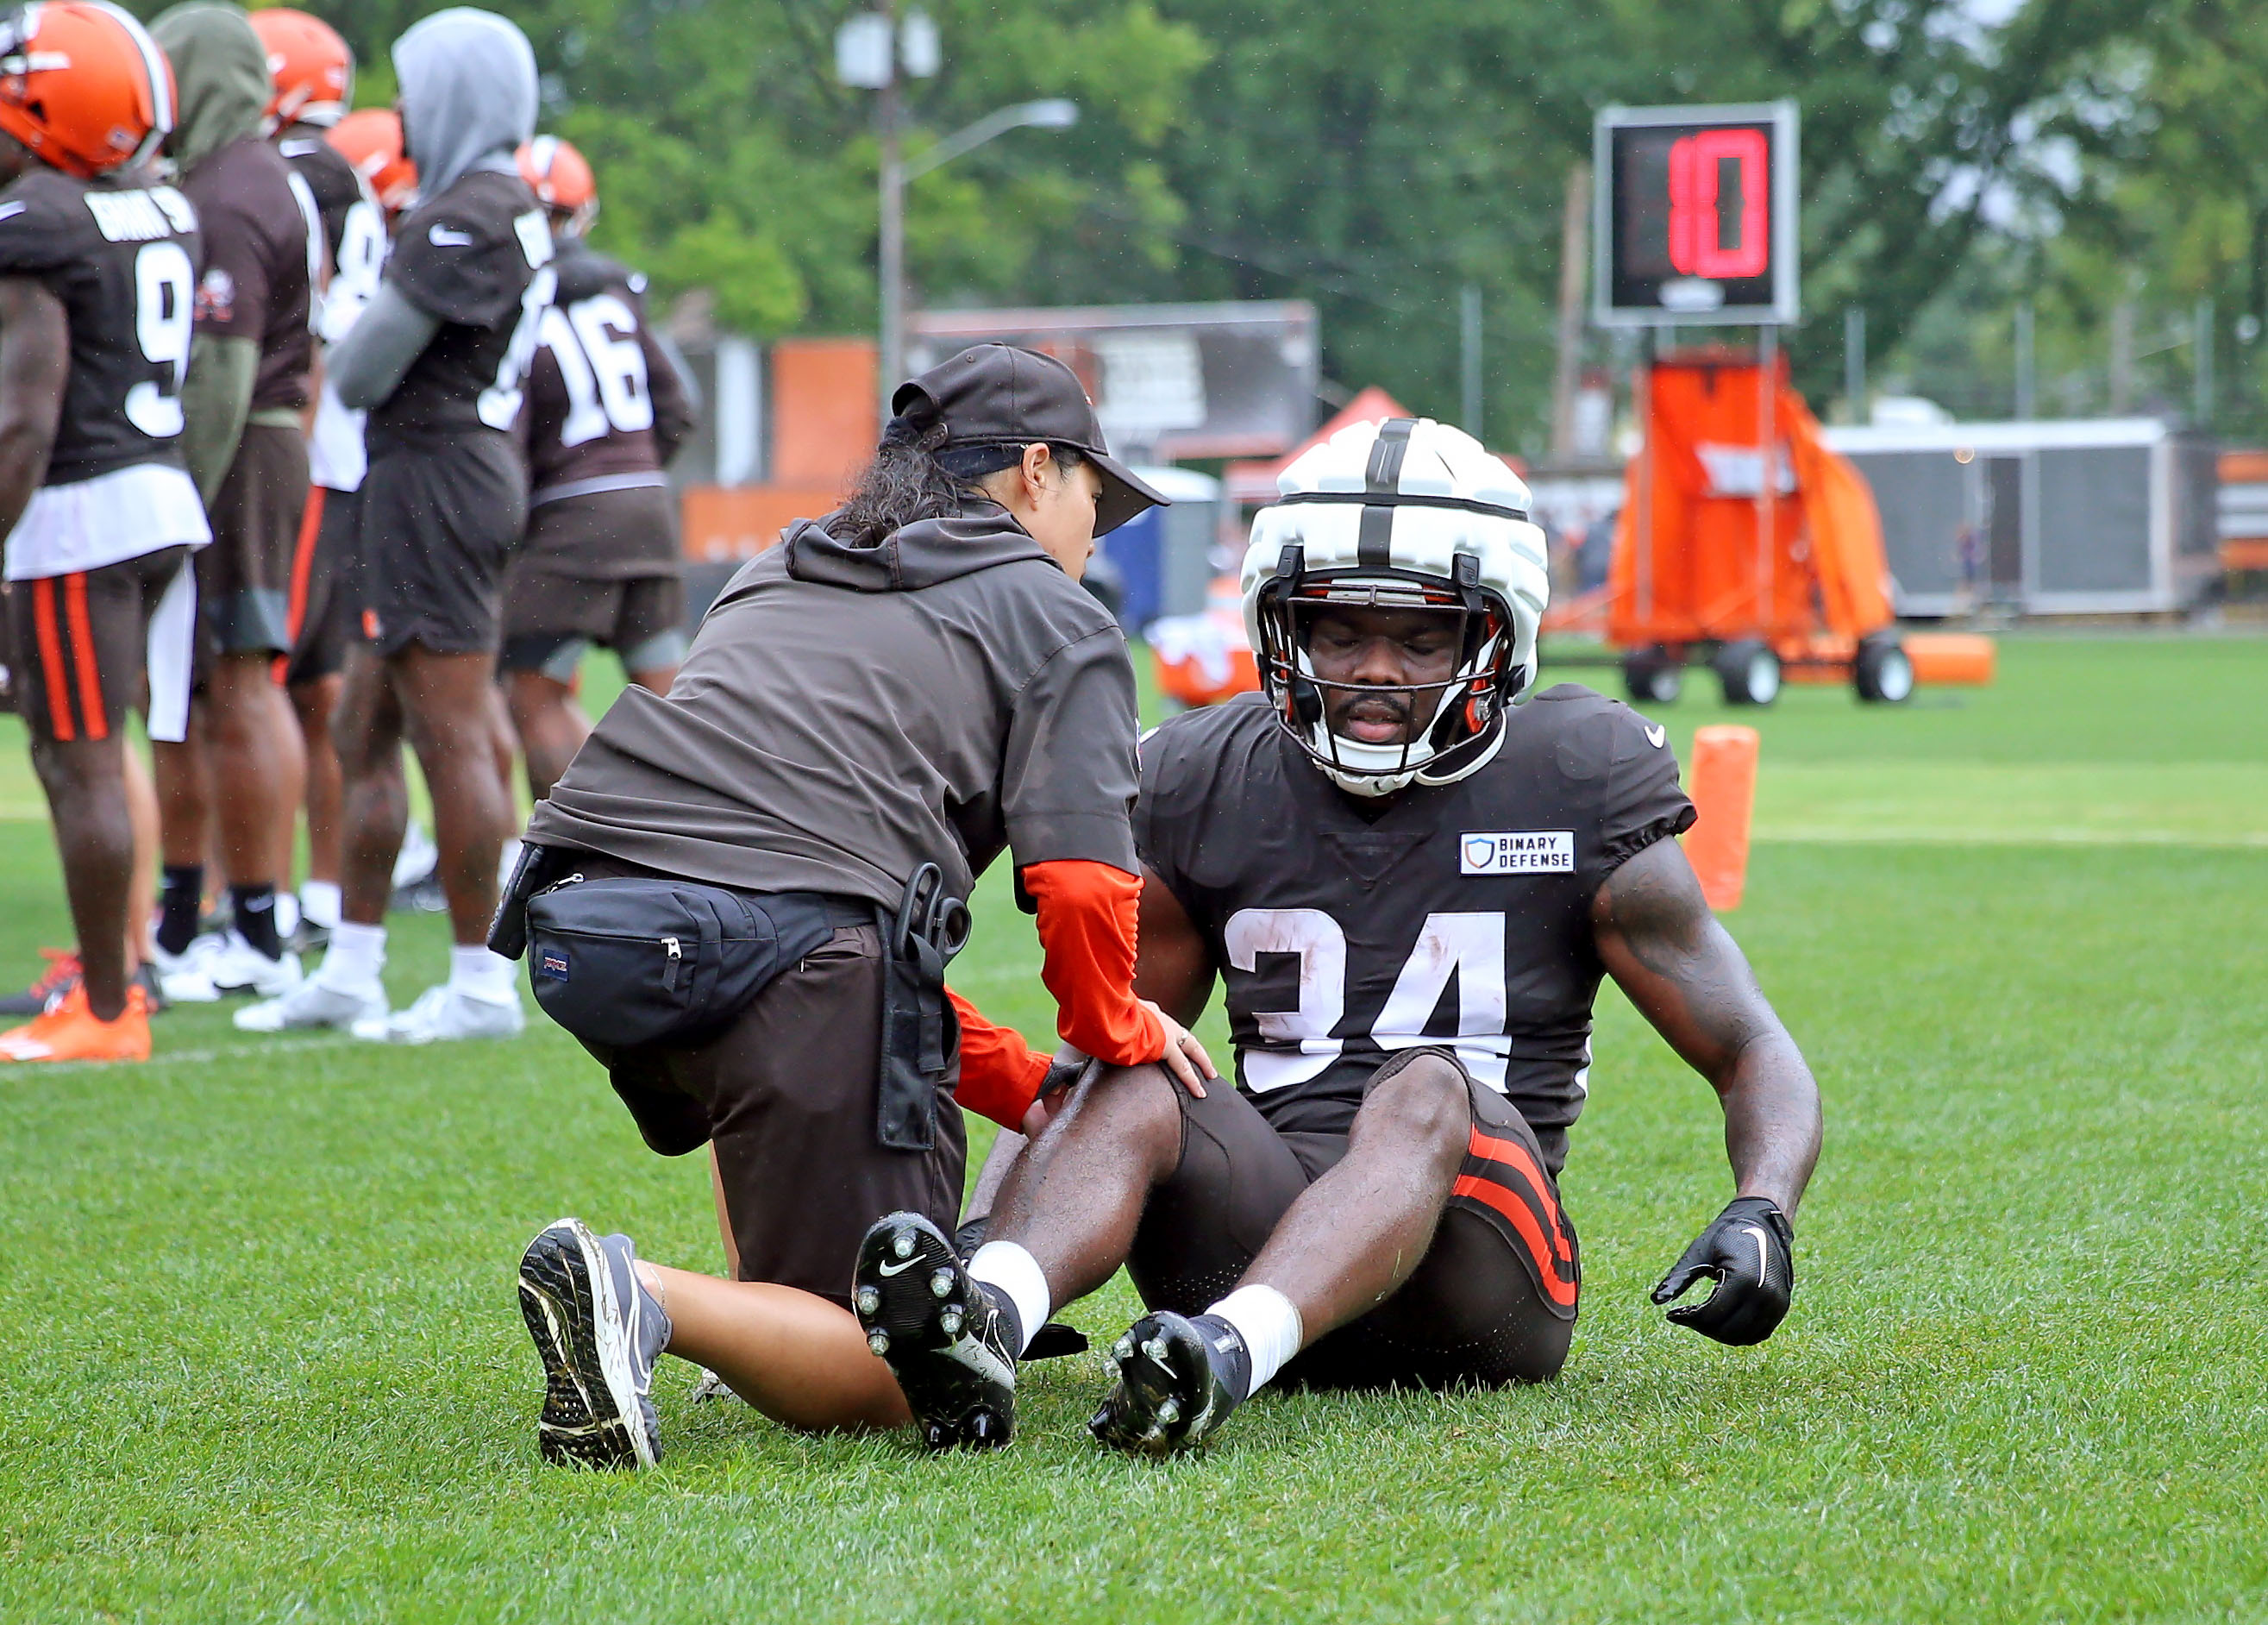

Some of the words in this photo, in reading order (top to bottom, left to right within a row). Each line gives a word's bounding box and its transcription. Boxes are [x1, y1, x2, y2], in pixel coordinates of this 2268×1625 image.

[1669, 129, 1768, 279] 10
[125, 241, 195, 437] 9
[539, 294, 655, 448] 16
[1499, 837, 1557, 851] BINARY
[1499, 853, 1569, 868] DEFENSE
[1224, 908, 1512, 1093] 34
